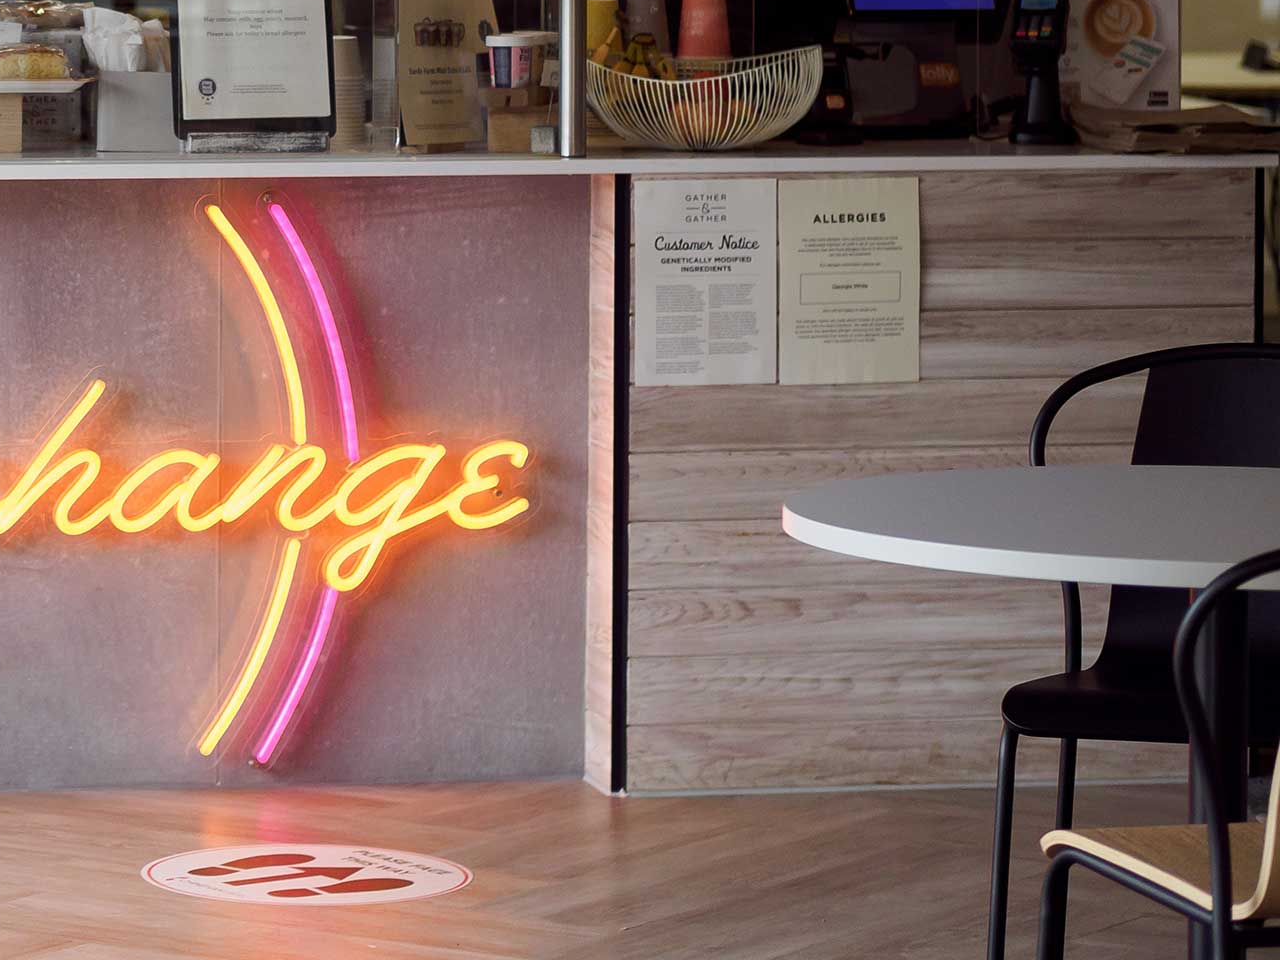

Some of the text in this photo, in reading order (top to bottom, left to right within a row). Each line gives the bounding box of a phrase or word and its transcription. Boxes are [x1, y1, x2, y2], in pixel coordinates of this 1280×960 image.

[684, 194, 728, 202] GATHER
[685, 215, 728, 223] GATHER
[813, 212, 887, 224] ALLERGIES
[654, 234, 760, 251] Customer Notice
[660, 256, 753, 265] GENETICALLY MODIFIED
[680, 265, 733, 273] INGREDIENTS
